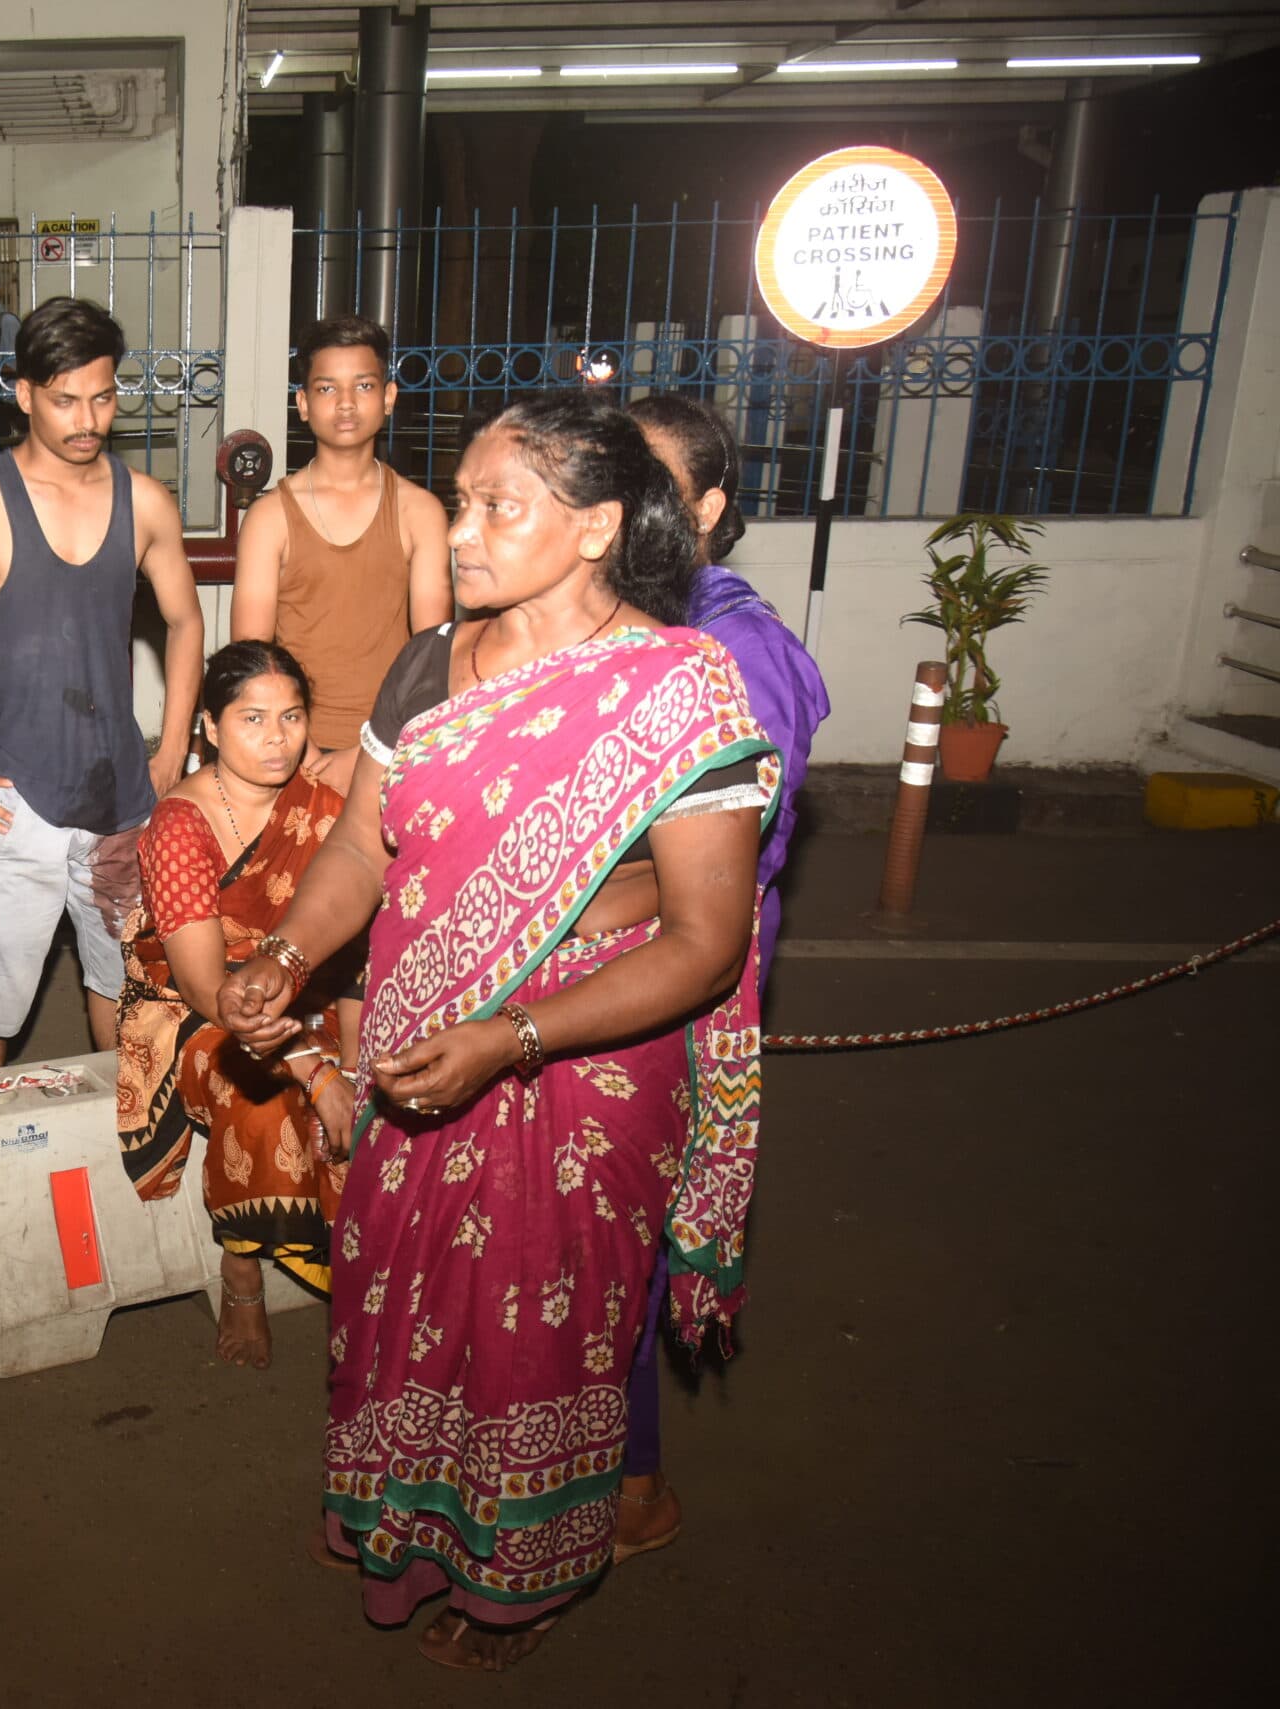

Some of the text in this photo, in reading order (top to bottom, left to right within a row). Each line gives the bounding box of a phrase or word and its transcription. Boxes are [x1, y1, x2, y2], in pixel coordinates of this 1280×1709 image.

[828, 173, 887, 193] मरीज
[51, 222, 96, 232] CAUTION
[807, 222, 905, 242] PATIENT
[793, 244, 915, 265] CROSSING
